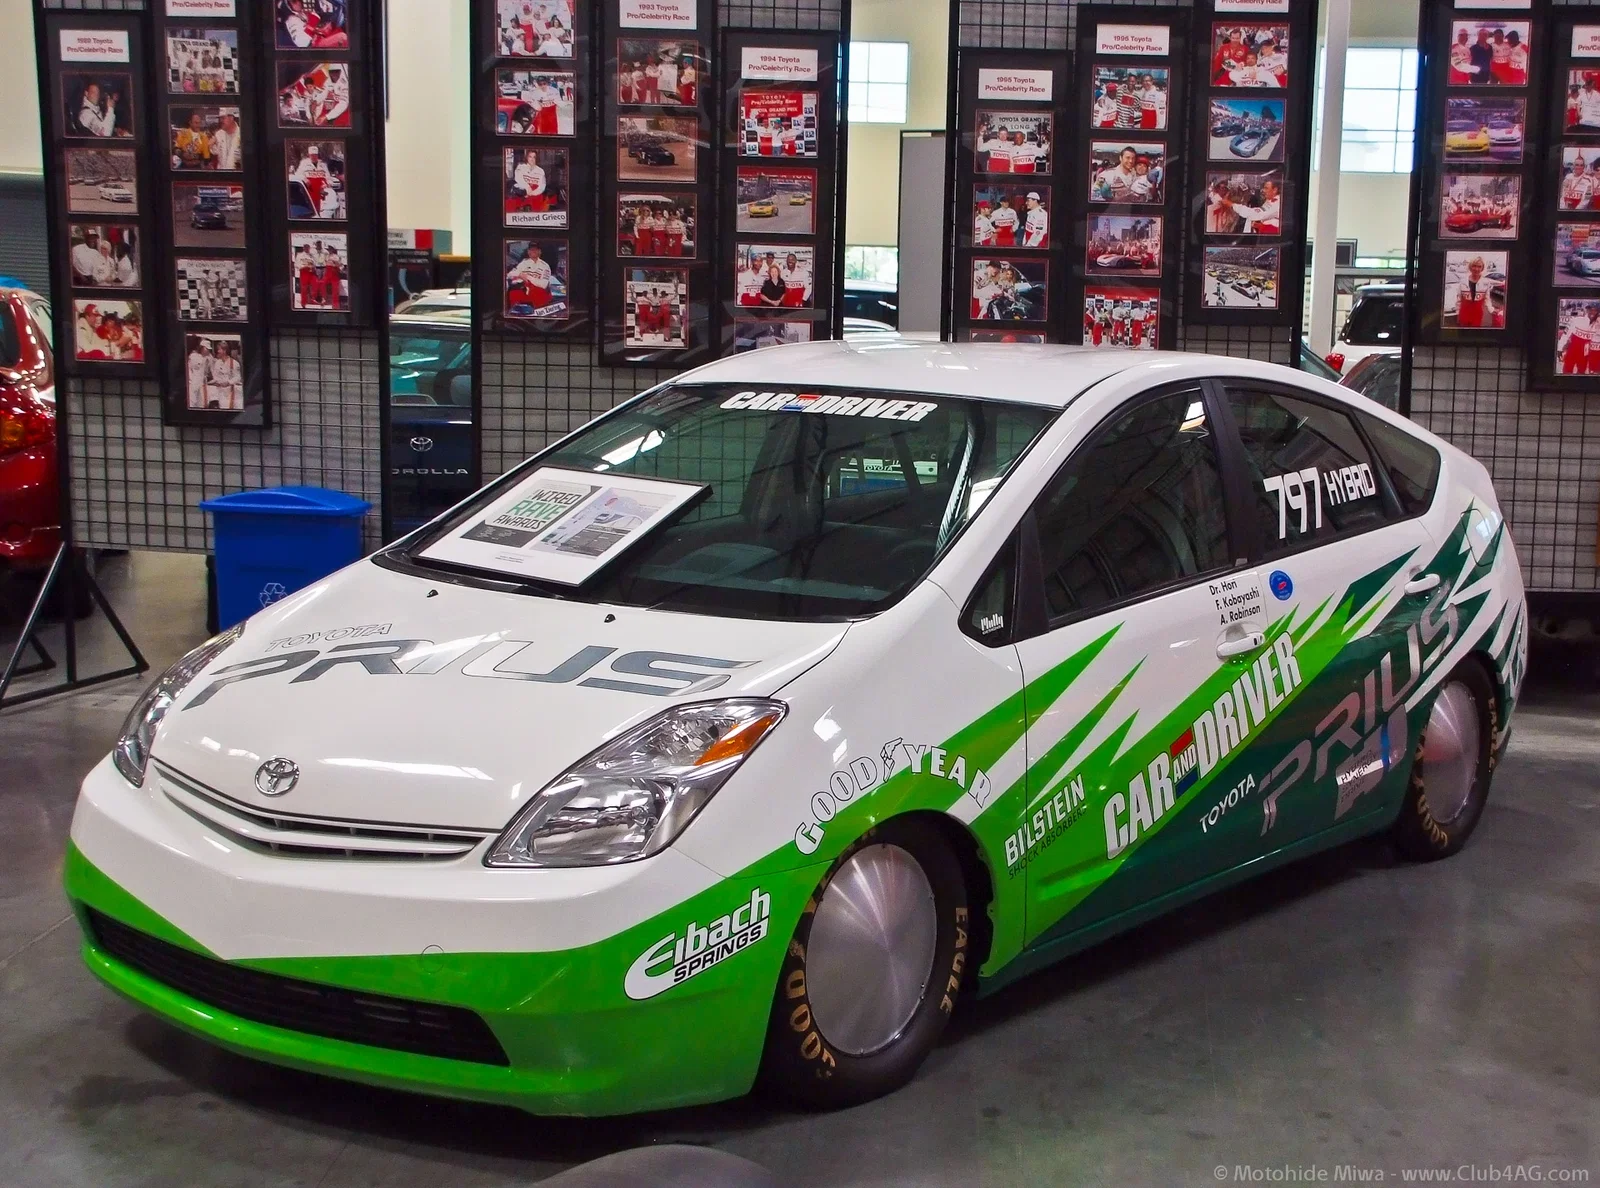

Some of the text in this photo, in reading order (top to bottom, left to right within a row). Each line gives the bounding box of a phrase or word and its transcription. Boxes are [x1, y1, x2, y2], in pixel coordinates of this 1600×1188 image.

[627, 12, 672, 21] Pro/Celebrity
[656, 4, 679, 12] Toyota
[67, 46, 106, 54] Pro/Celebrity
[1102, 43, 1144, 52] Pro/Celebrity
[748, 64, 811, 73] Pro/Celebrity Race
[985, 85, 1028, 93] Pro/Celebrity
[511, 212, 566, 223] Richard Grieco
[719, 391, 797, 411] CAR
[802, 395, 938, 422] DRIVER
[531, 489, 583, 505] WIRED
[1263, 463, 1376, 539] 797 HYBRID
[506, 500, 568, 520] RAVE
[493, 514, 548, 530] AWARDS
[1209, 585, 1221, 595] Dr.
[1215, 586, 1260, 610] F. Kobayashi
[1220, 605, 1260, 625] A. Robinson
[265, 622, 393, 652] TOYOTA
[181, 636, 758, 712] PRIUS
[1257, 577, 1459, 837] PRIUS
[1103, 630, 1303, 861] CAR AND DRIVER
[1200, 773, 1256, 833] TOYOTA
[1004, 773, 1086, 868] BILSTEIN
[1008, 848, 1040, 880] SHOCK
[623, 886, 771, 1000] Eibach
[673, 924, 762, 983] SPRINGS
